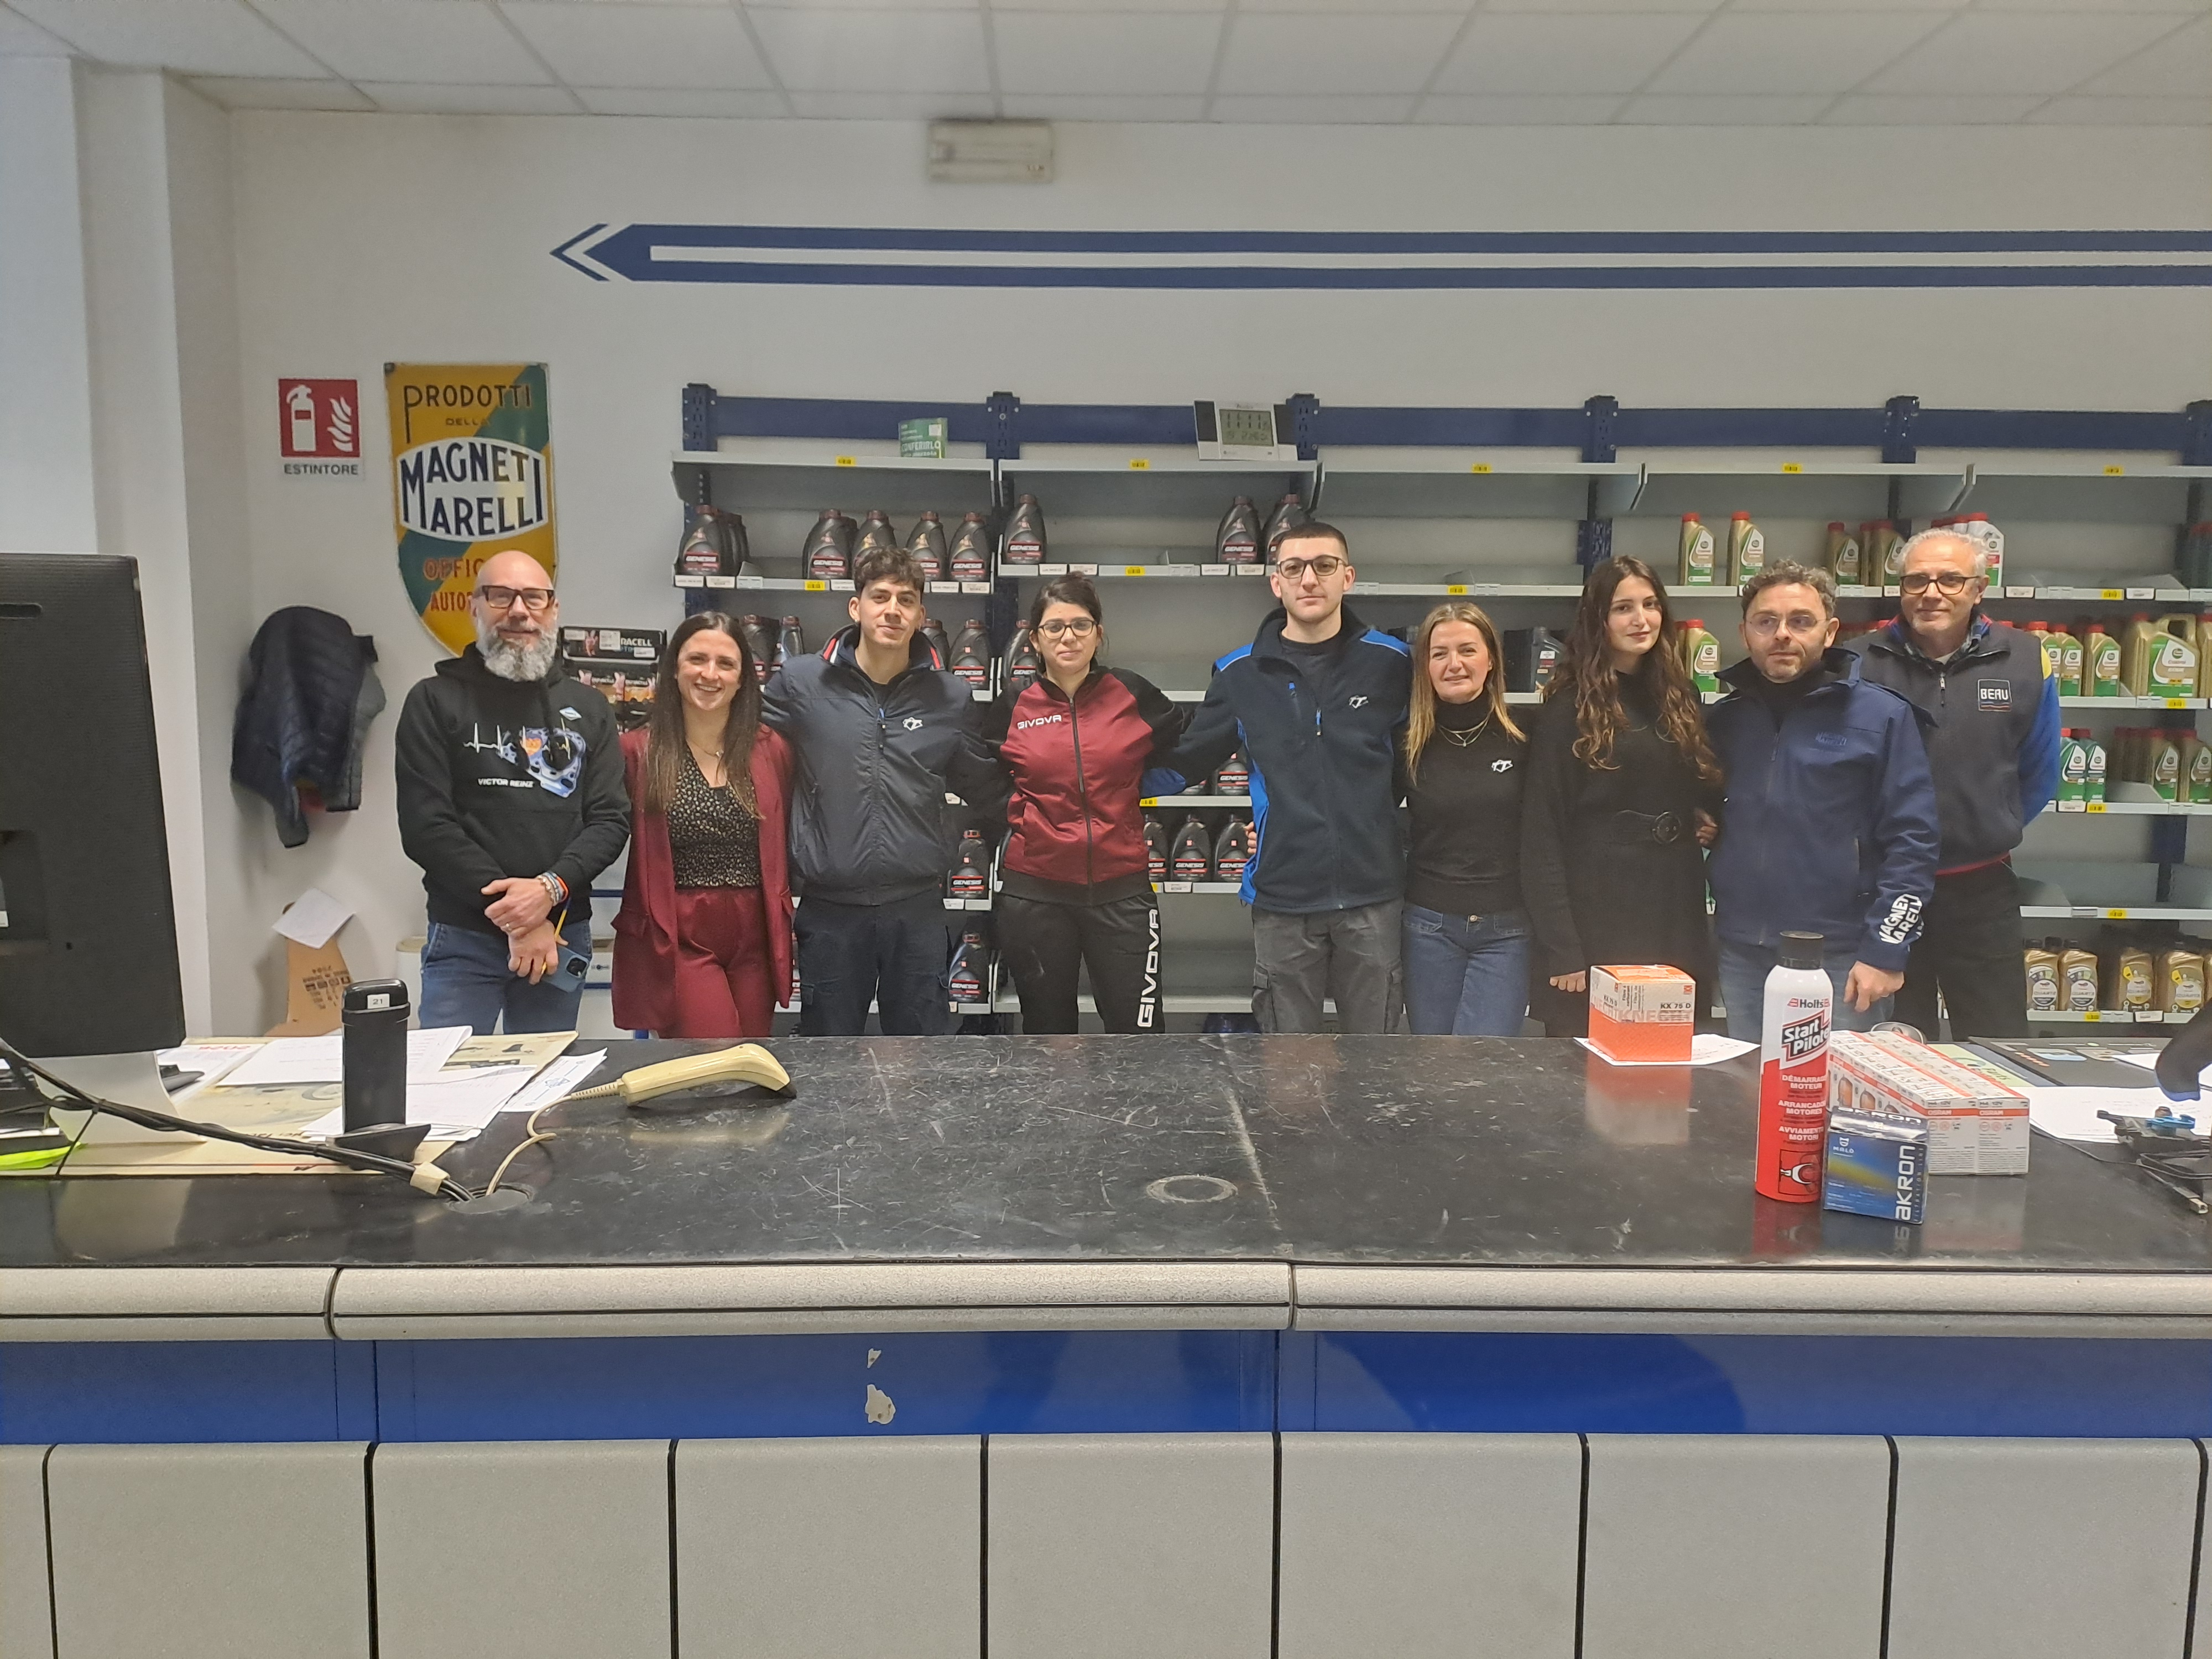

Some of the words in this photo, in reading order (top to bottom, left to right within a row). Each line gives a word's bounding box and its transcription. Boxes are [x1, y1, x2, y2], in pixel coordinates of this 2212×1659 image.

[404, 384, 530, 430] PRODOTTI
[284, 463, 358, 475] ESTINTORE
[400, 443, 544, 497] MAGNETI
[400, 483, 544, 536] MARELLI
[620, 637, 652, 646] RACELL
[1017, 714, 1062, 731] GIVOVA
[1137, 909, 1160, 1027] GIVOVA
[1799, 999, 1824, 1008] Holts
[1783, 1018, 1819, 1043] Start
[1793, 1027, 1829, 1055] Pilote
[1778, 1100, 1826, 1108] ARRANCADO
